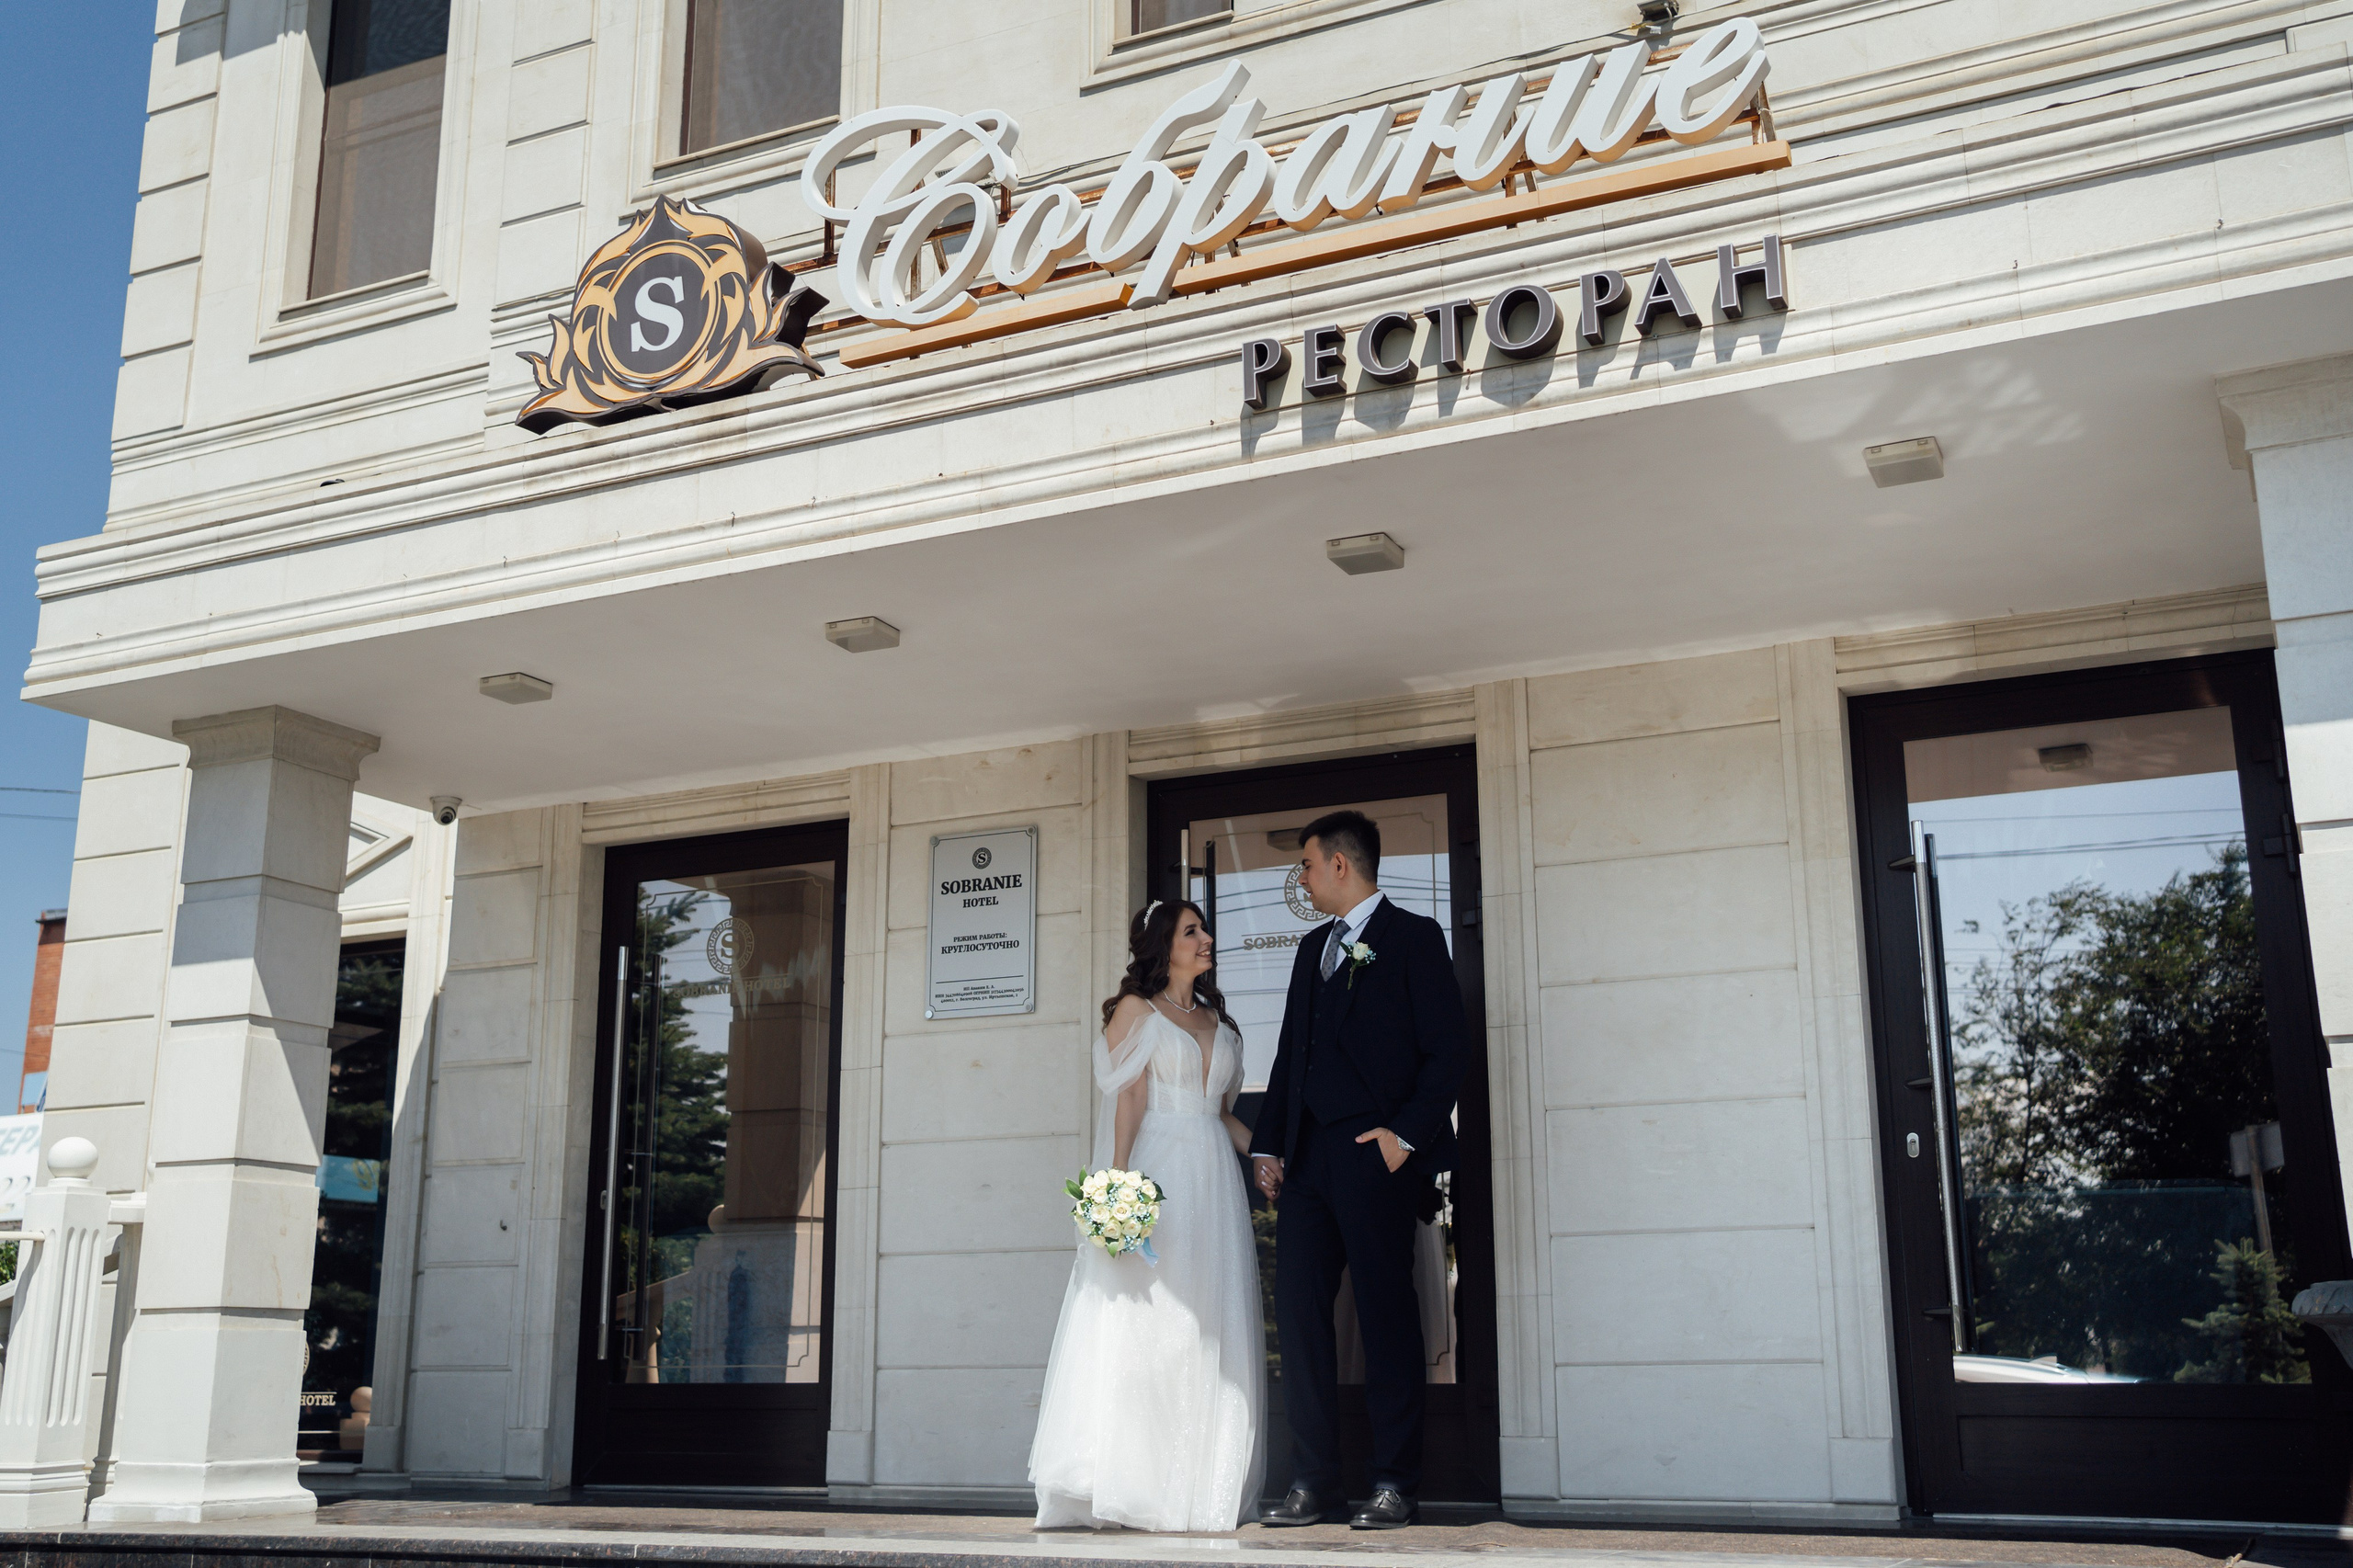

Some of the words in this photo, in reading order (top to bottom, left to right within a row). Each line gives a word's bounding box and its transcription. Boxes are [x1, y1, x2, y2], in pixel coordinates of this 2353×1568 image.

[802, 17, 1770, 328] Собрание
[631, 276, 685, 353] S
[1242, 233, 1788, 410] РЕСТОРАН
[941, 874, 1022, 895] SOBRANIE
[962, 896, 999, 908] HOTEL
[941, 940, 1019, 954] КРУГЛОСУТОЧНО
[953, 935, 978, 943] РЕЖИМ
[979, 932, 1007, 940] РАБОТЫ:
[1244, 934, 1305, 950] SOBRA
[673, 981, 739, 999] SOBRANIE
[745, 977, 791, 993] HOTEL
